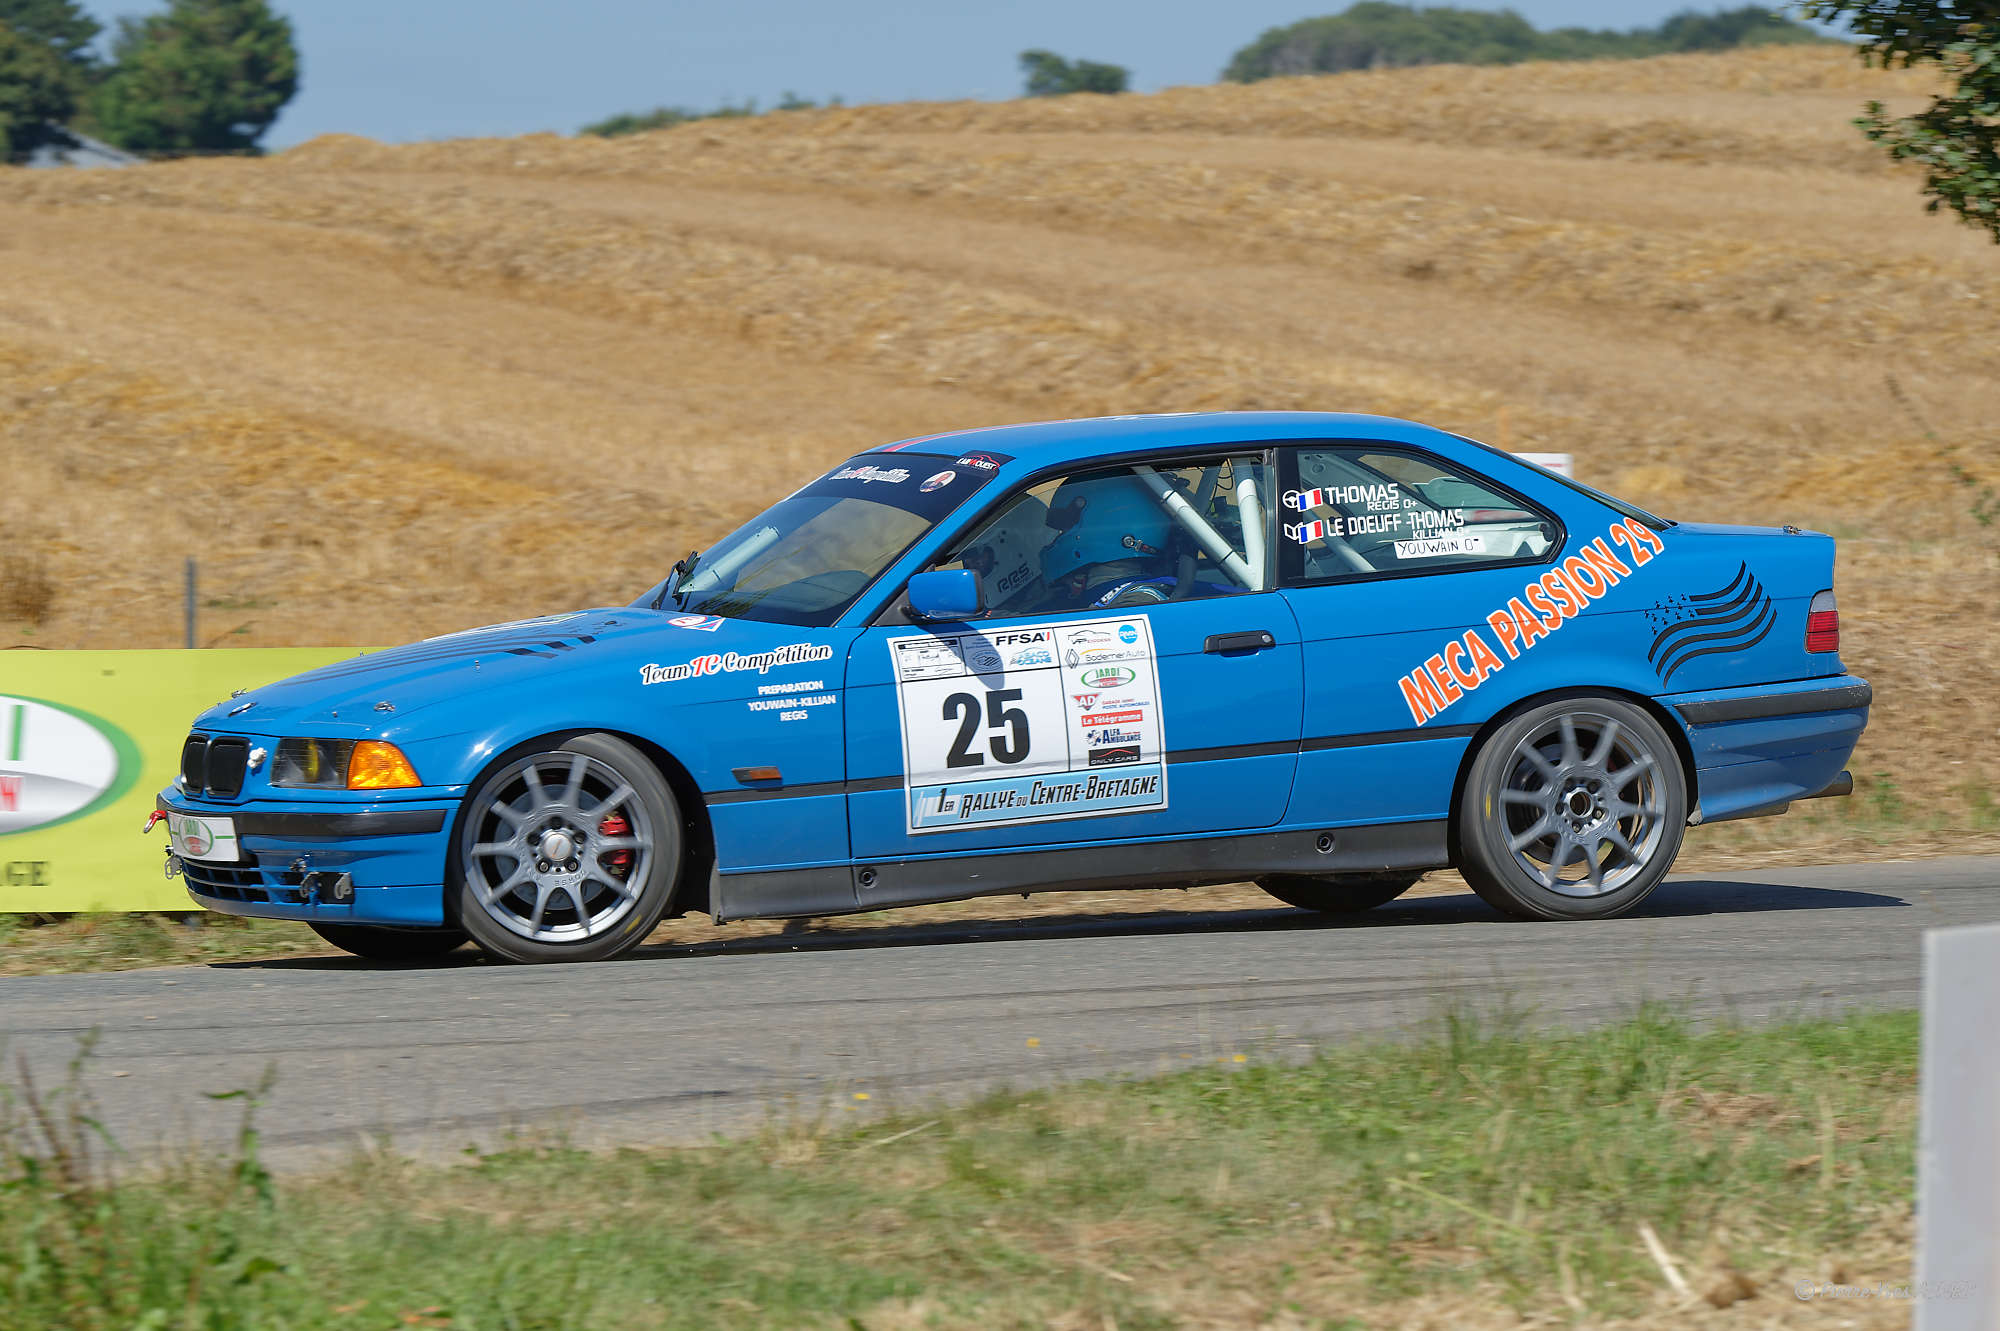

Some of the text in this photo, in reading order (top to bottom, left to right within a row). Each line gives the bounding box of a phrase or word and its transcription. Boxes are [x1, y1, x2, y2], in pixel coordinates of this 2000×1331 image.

[1325, 483, 1400, 505] THOMAS
[1367, 500, 1400, 511] REGIS
[1327, 517, 1345, 537] LE
[1348, 513, 1402, 535] DOEUFF
[1412, 528, 1453, 540] KILLIAN
[1398, 540, 1459, 555] YOUWAIN
[1399, 516, 1665, 727] MECA PASSION 29
[996, 632, 1044, 647] FFSA
[641, 664, 689, 683] Team
[723, 644, 831, 673] Compétition
[1095, 667, 1120, 678] JARDI
[758, 680, 824, 695] PREPARATION
[1079, 695, 1096, 706] AD
[780, 710, 808, 722] REGIS
[942, 688, 1031, 769] 25
[960, 790, 1016, 818] RALLYE
[1030, 775, 1159, 805] CENTRE-BRETAGNE
